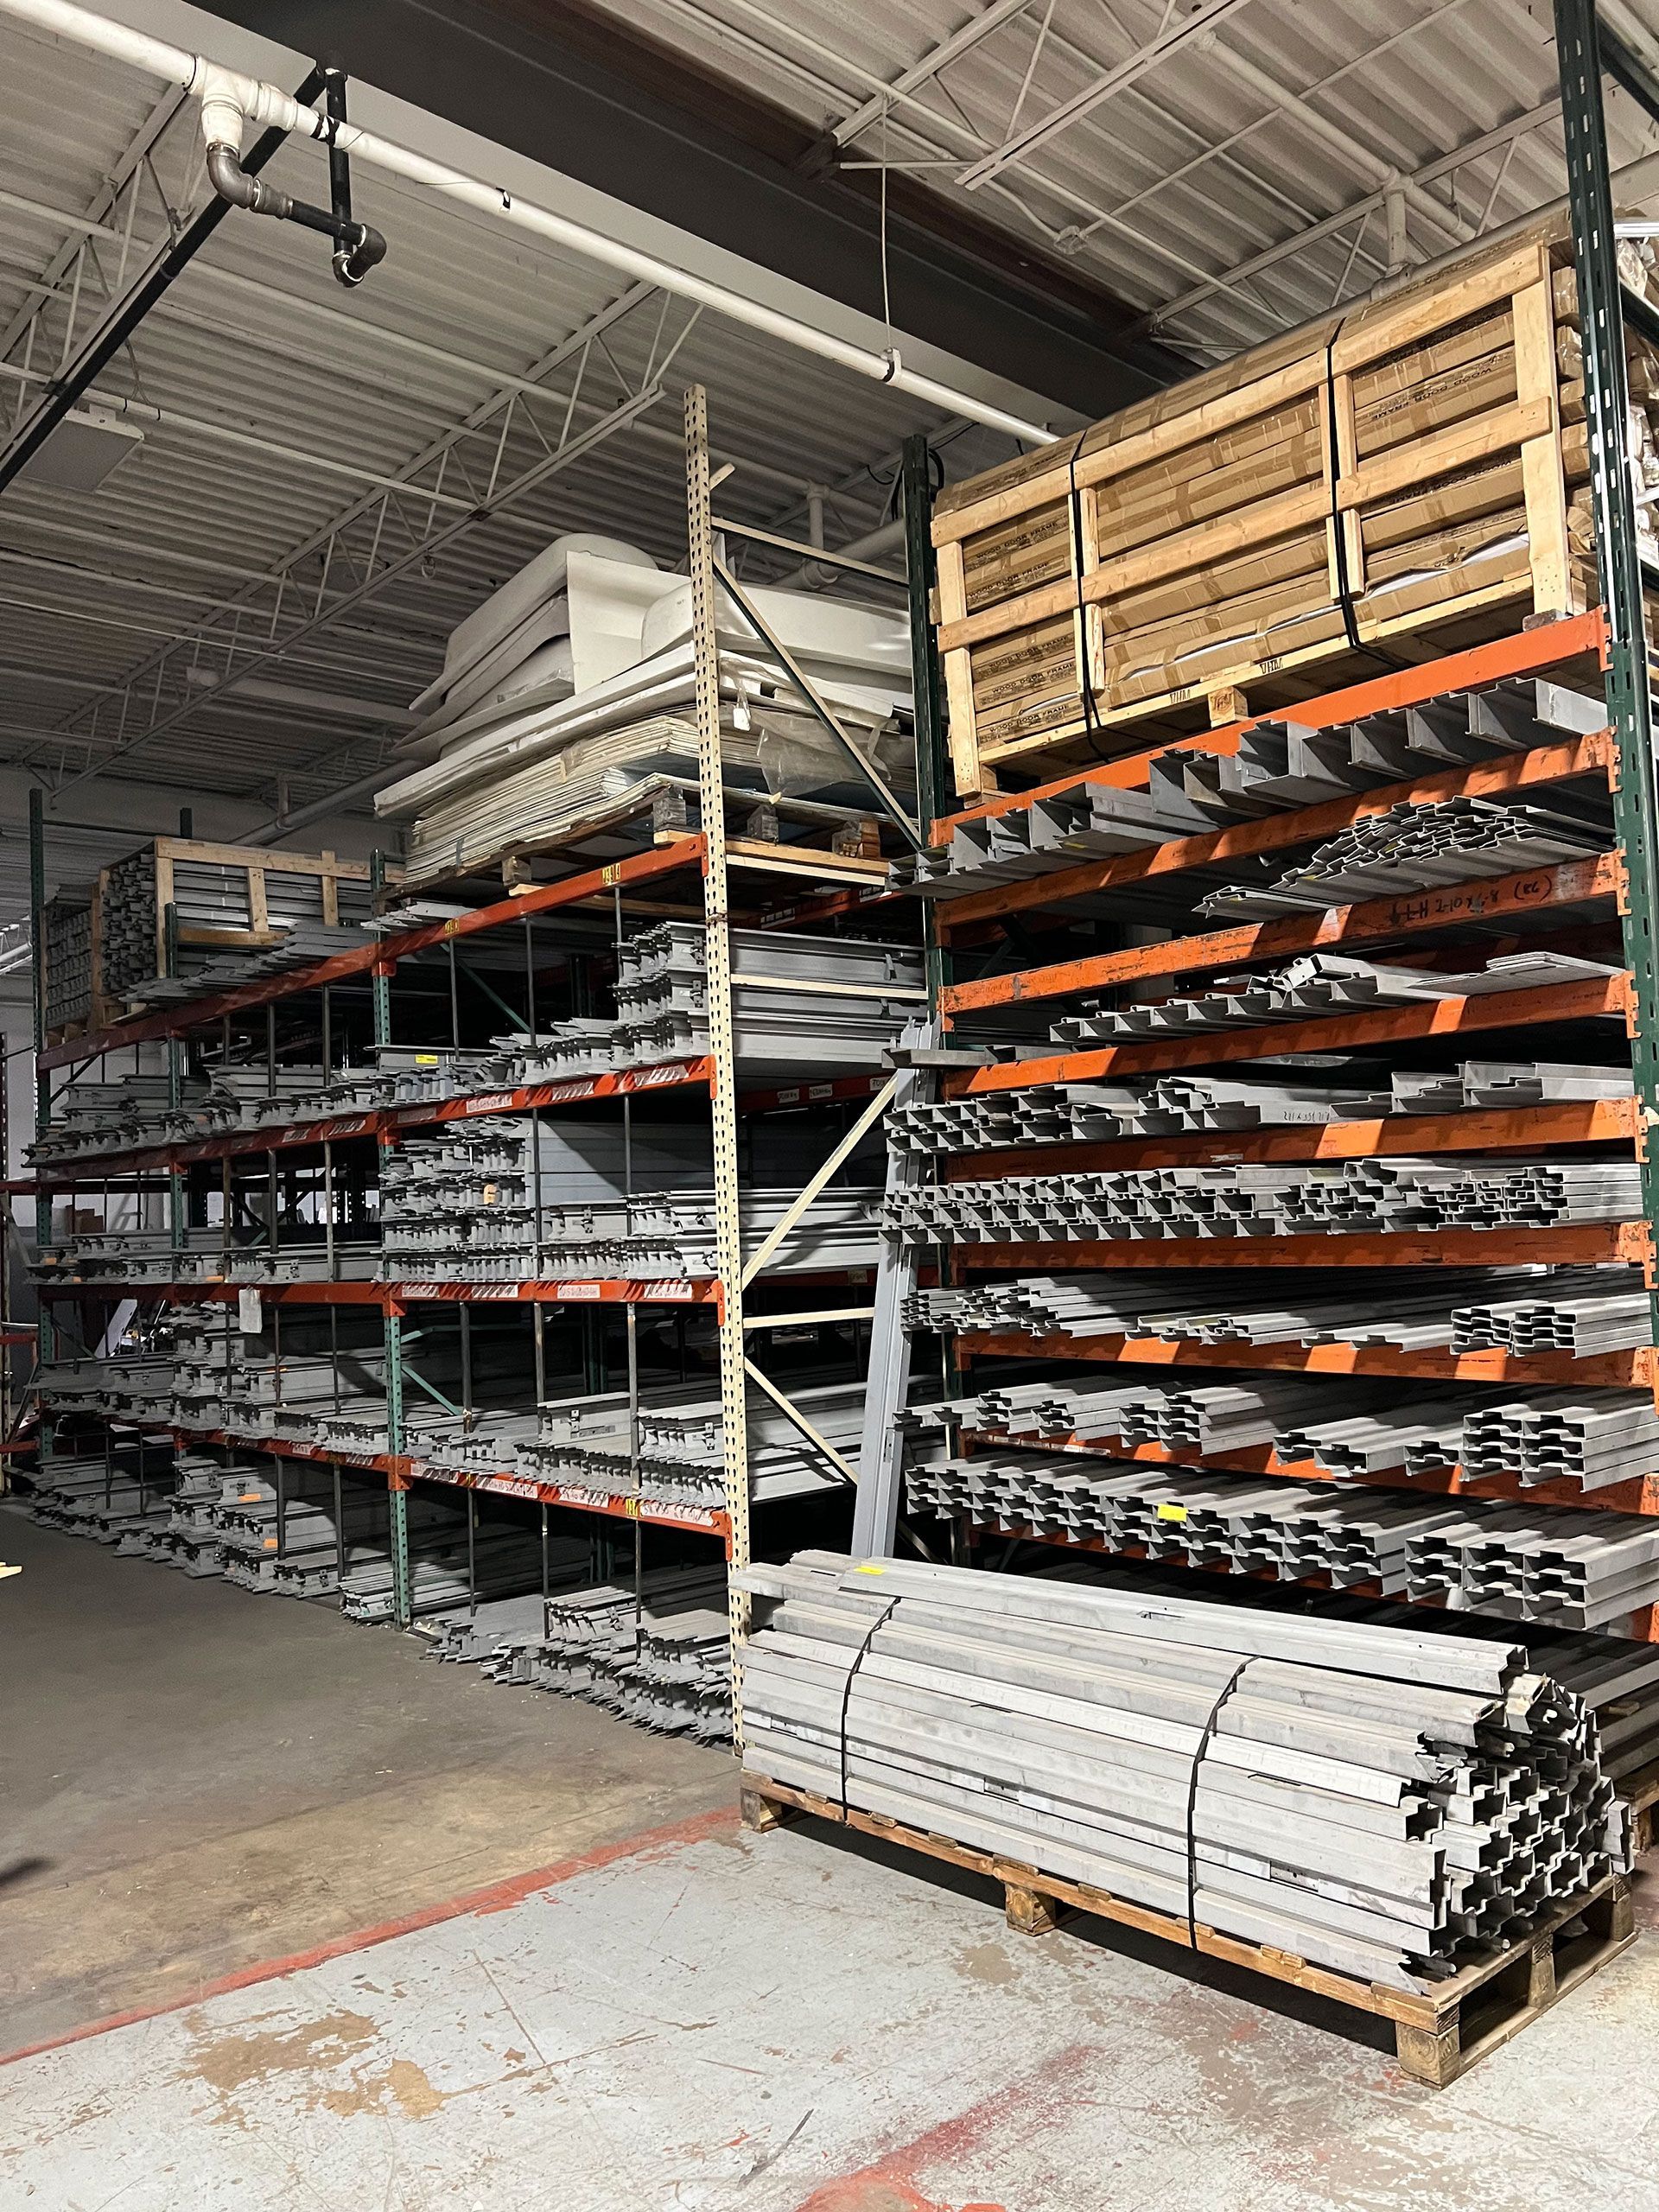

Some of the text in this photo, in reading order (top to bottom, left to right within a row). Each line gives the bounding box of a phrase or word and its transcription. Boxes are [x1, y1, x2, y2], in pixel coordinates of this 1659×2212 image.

[1453, 368, 1492, 386] WOOD
[1414, 385, 1448, 403] DOOR
[976, 545, 1001, 559] WOOD
[1004, 534, 1027, 548] DOOR
[1030, 520, 1058, 537] FRAME
[989, 636, 1069, 668] WOOD DOOR FRAME
[992, 662, 1074, 694] WOOD DOOR FRAME
[989, 703, 1070, 734] WOOD DOOR FRAME
